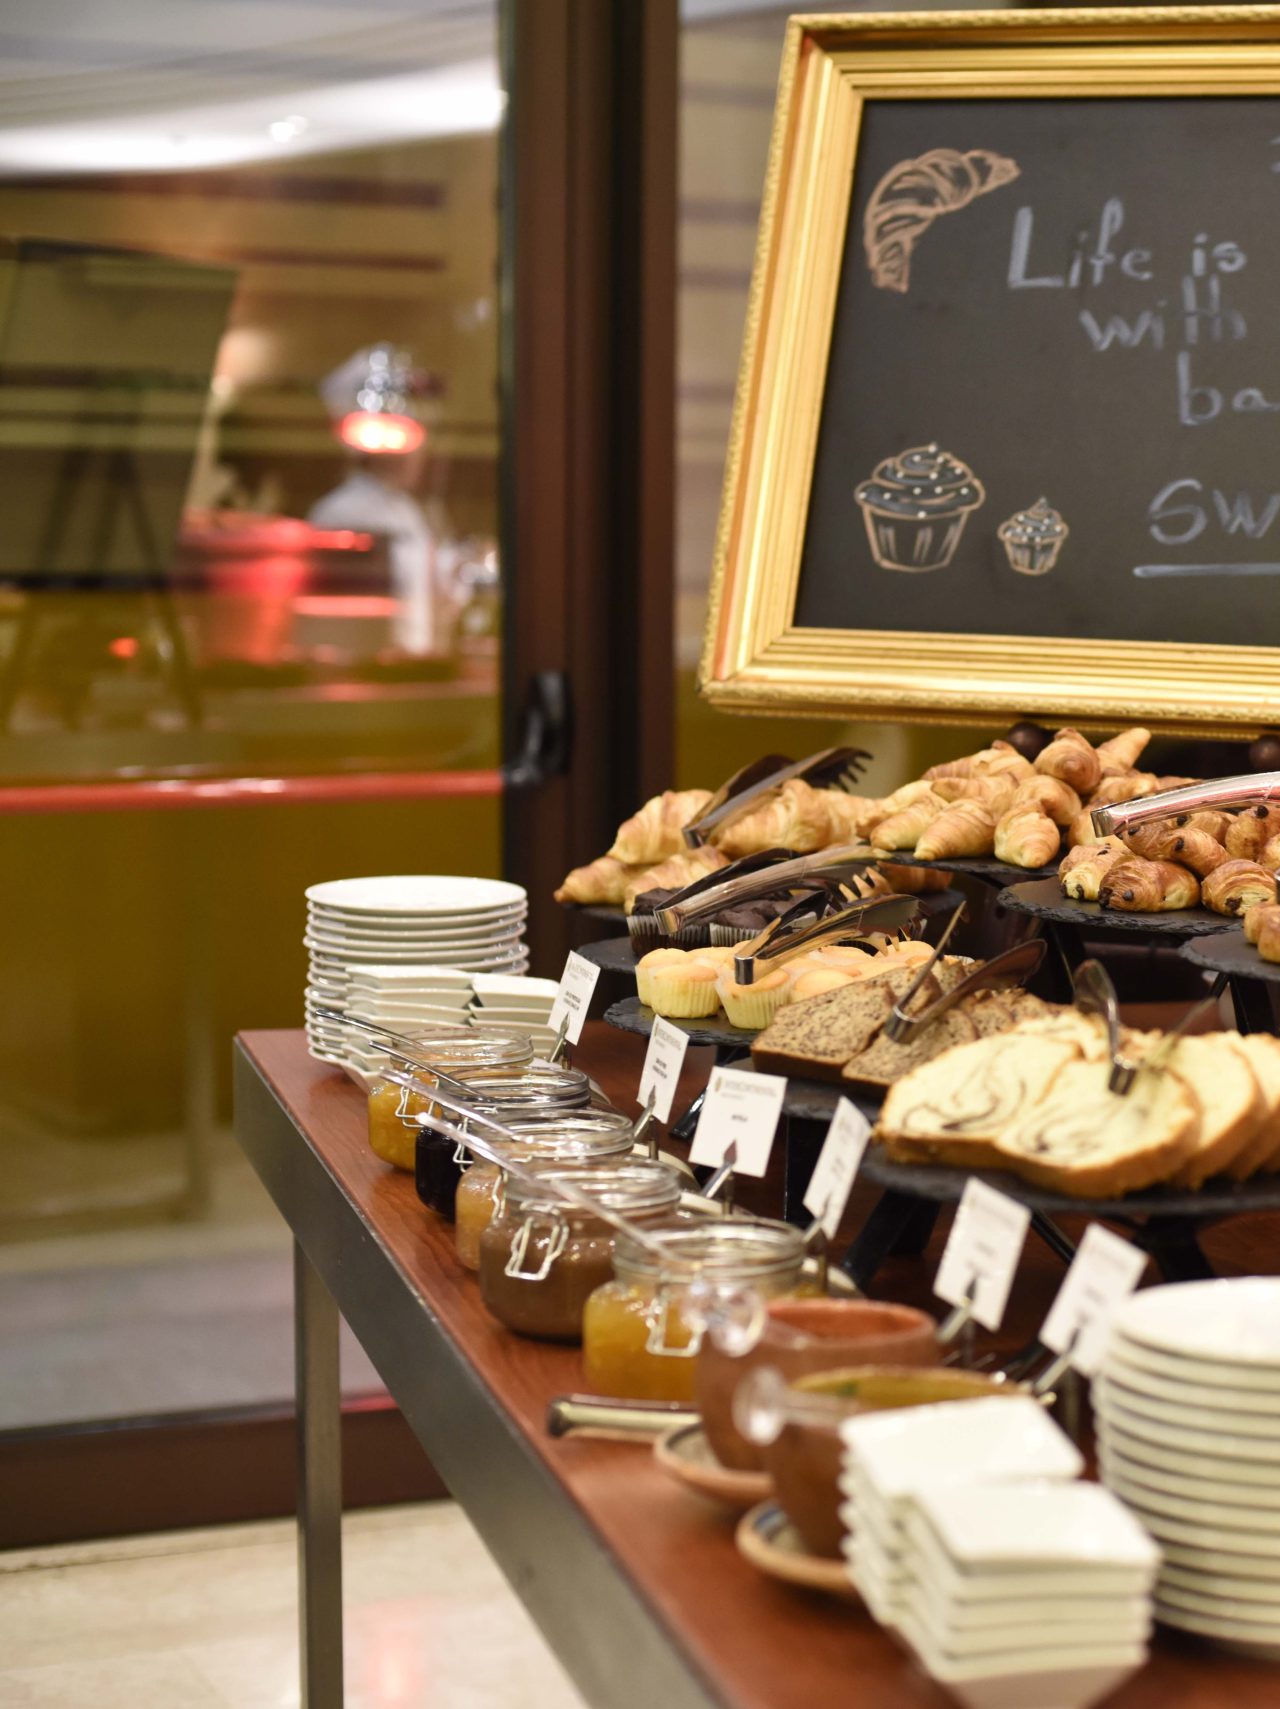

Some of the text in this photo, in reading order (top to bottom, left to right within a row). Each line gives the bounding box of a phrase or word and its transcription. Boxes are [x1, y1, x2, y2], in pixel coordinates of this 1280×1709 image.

[1006, 197, 1153, 290] Life
[1191, 233, 1248, 275] is
[1079, 276, 1246, 350] with
